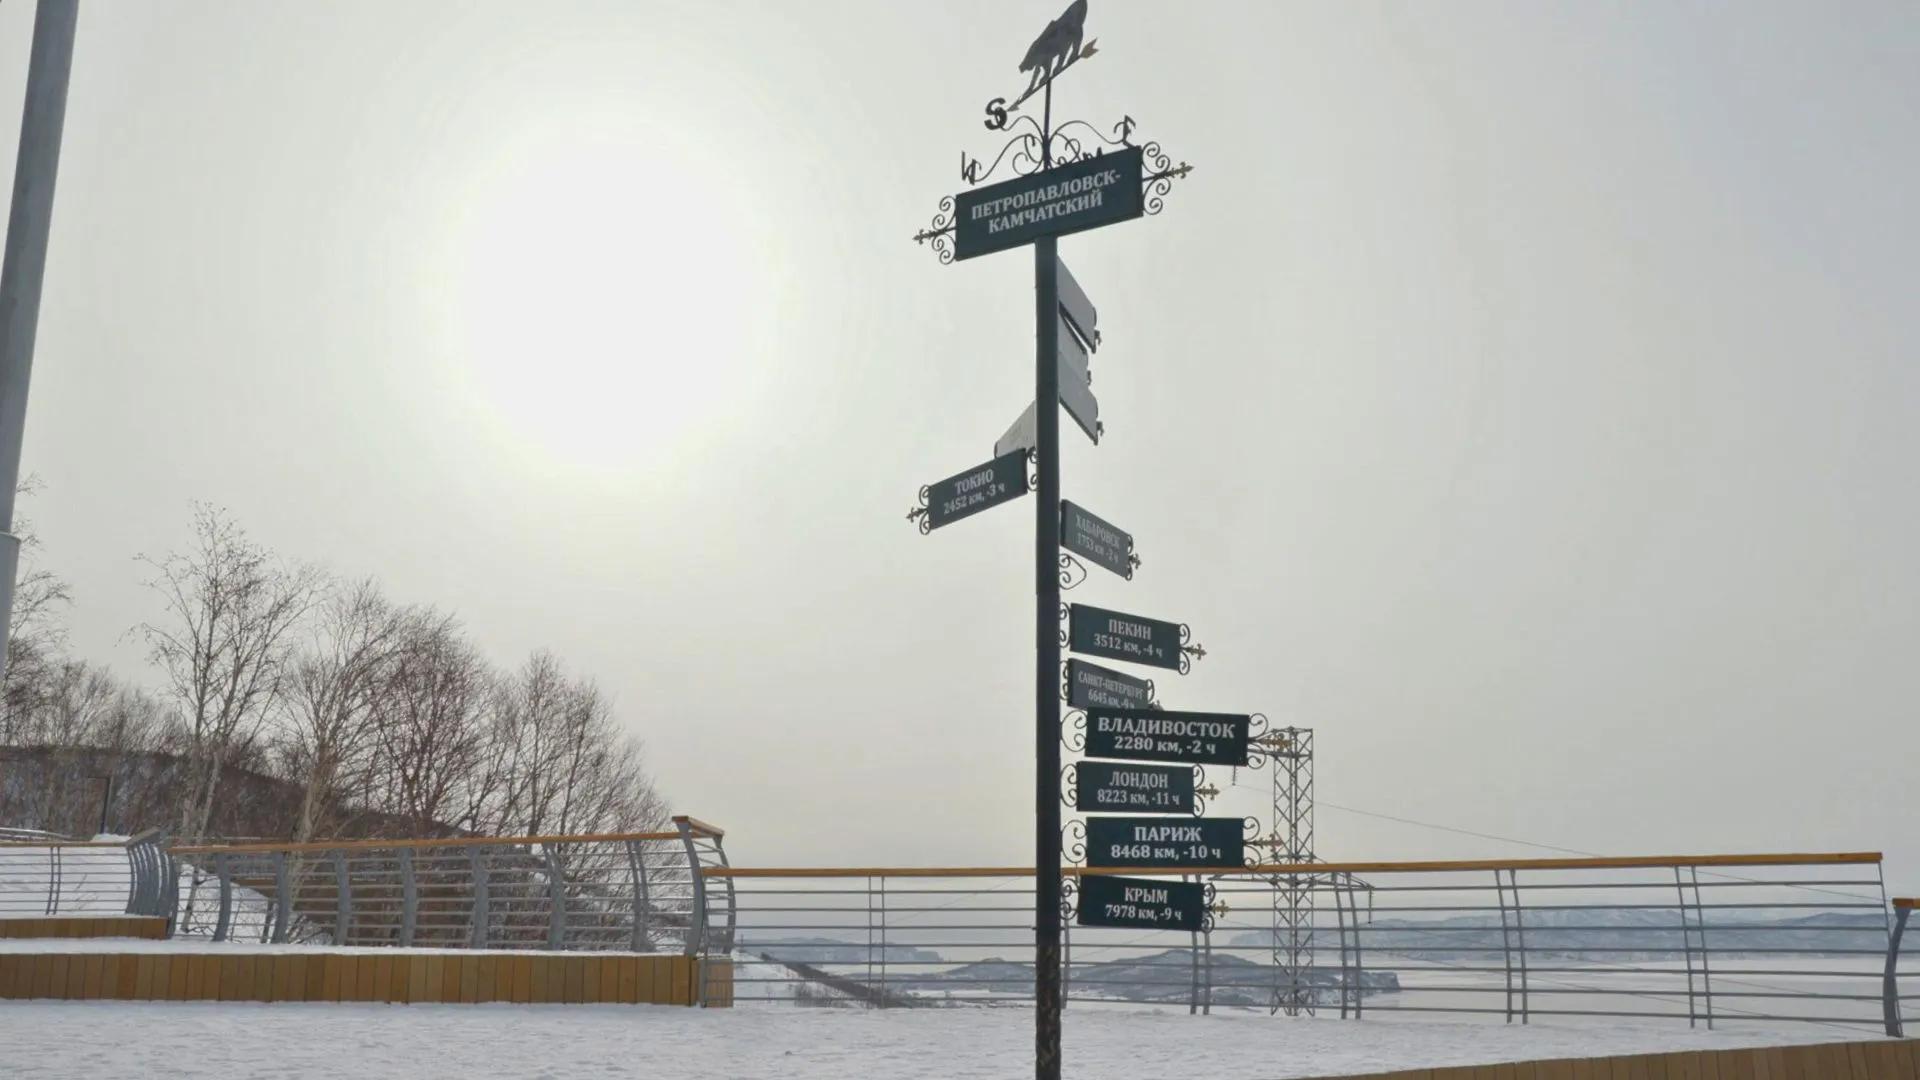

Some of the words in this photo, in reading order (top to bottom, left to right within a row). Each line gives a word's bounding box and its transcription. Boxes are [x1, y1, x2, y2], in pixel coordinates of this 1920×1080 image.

[971, 169, 1121, 220] ПЕТРОПАВЛОВСК-
[988, 190, 1103, 234] КАМЧАТСКИЙ
[955, 468, 994, 495] ТОКИО
[943, 494, 968, 515] 2452
[998, 482, 1006, 493] ч
[1108, 618, 1152, 640] ПЕКИН
[1093, 633, 1121, 650] 3512
[1123, 642, 1142, 656] км,
[1143, 644, 1153, 656] -4
[1156, 649, 1163, 657] ч
[1097, 717, 1236, 739] ВЛАДИВОСТОК
[1114, 736, 1153, 751] 2280
[1157, 741, 1182, 754] км,
[1186, 740, 1202, 754] -2
[1206, 744, 1216, 754] ч
[1109, 771, 1169, 789] ЛОНДОН
[1097, 789, 1127, 804] 8223
[1130, 794, 1150, 806] км,
[1151, 792, 1170, 805] -11
[1172, 795, 1180, 805] ч
[1134, 826, 1202, 842] ПАРИЖ
[1111, 844, 1150, 859] 8468
[1154, 848, 1180, 860] км,
[1183, 845, 1208, 859] -10
[1212, 849, 1221, 859] ч
[1124, 887, 1169, 904] КРЫМ
[1105, 904, 1136, 919] 7978
[1138, 908, 1158, 921] км,
[1160, 908, 1172, 920] -9
[1174, 911, 1182, 921] ч
